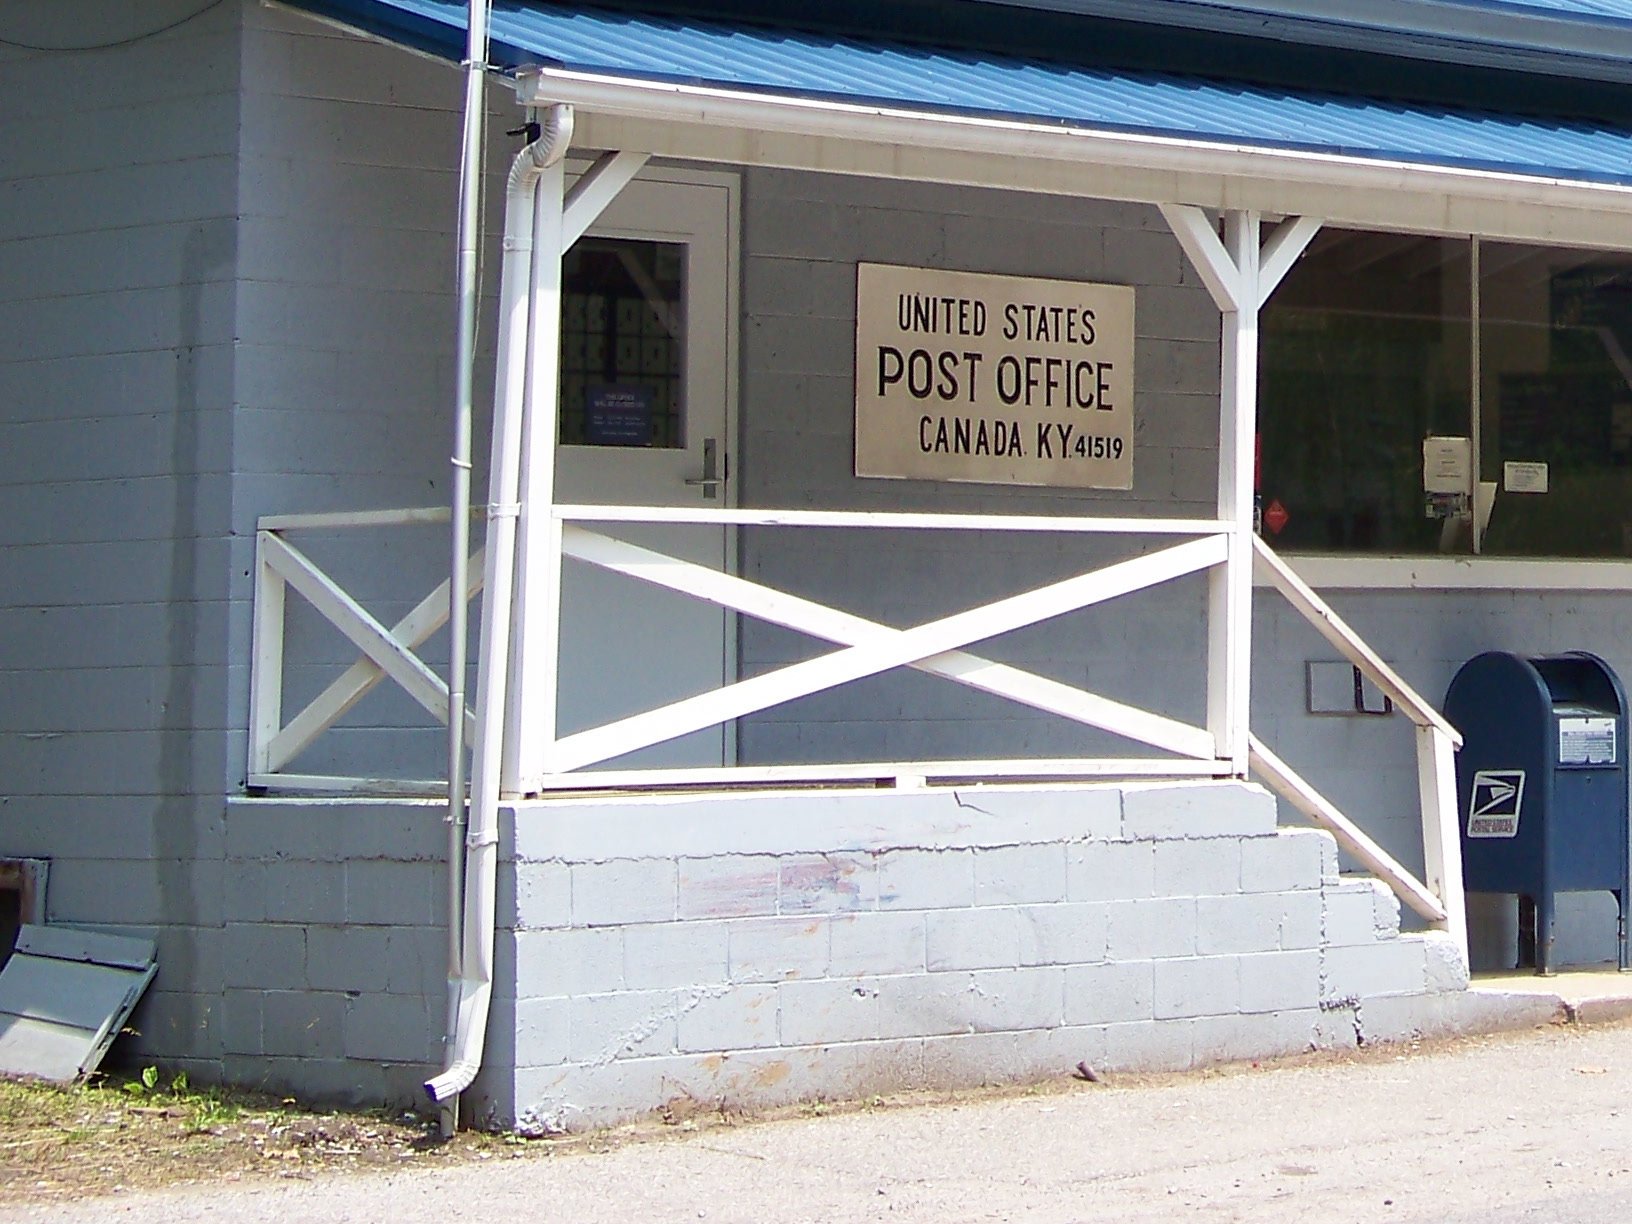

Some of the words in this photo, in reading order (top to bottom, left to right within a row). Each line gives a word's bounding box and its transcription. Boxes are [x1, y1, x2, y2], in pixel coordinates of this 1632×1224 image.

[899, 293, 987, 337] UNITED
[1002, 303, 1097, 346] STATES
[877, 346, 984, 402] POST
[996, 355, 1114, 412] OFFICE
[1074, 434, 1124, 460] 41519
